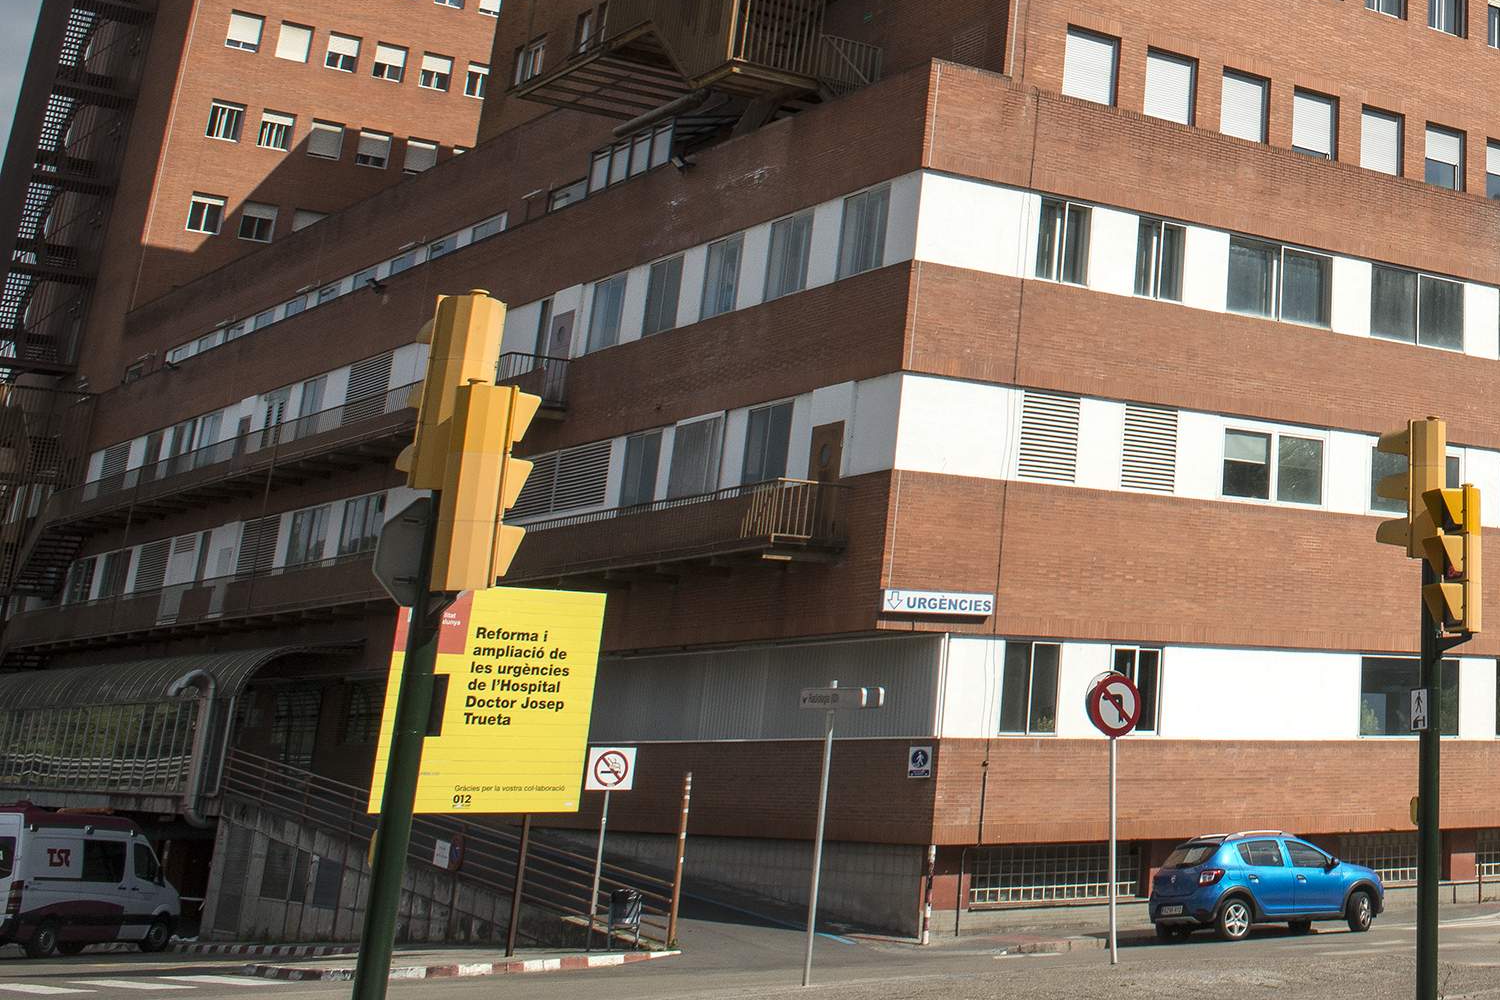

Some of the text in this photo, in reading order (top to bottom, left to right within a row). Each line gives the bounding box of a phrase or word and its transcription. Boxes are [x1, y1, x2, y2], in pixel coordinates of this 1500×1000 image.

[906, 594, 992, 612] URGÈNCIES
[475, 626, 549, 642] Reforma i
[472, 645, 568, 660] ampliació de
[470, 661, 570, 678] les urgències
[467, 678, 486, 691] de
[465, 695, 565, 713] Doctor Josep
[463, 711, 511, 726] Trueta
[481, 785, 493, 793] per
[453, 794, 472, 804] 012
